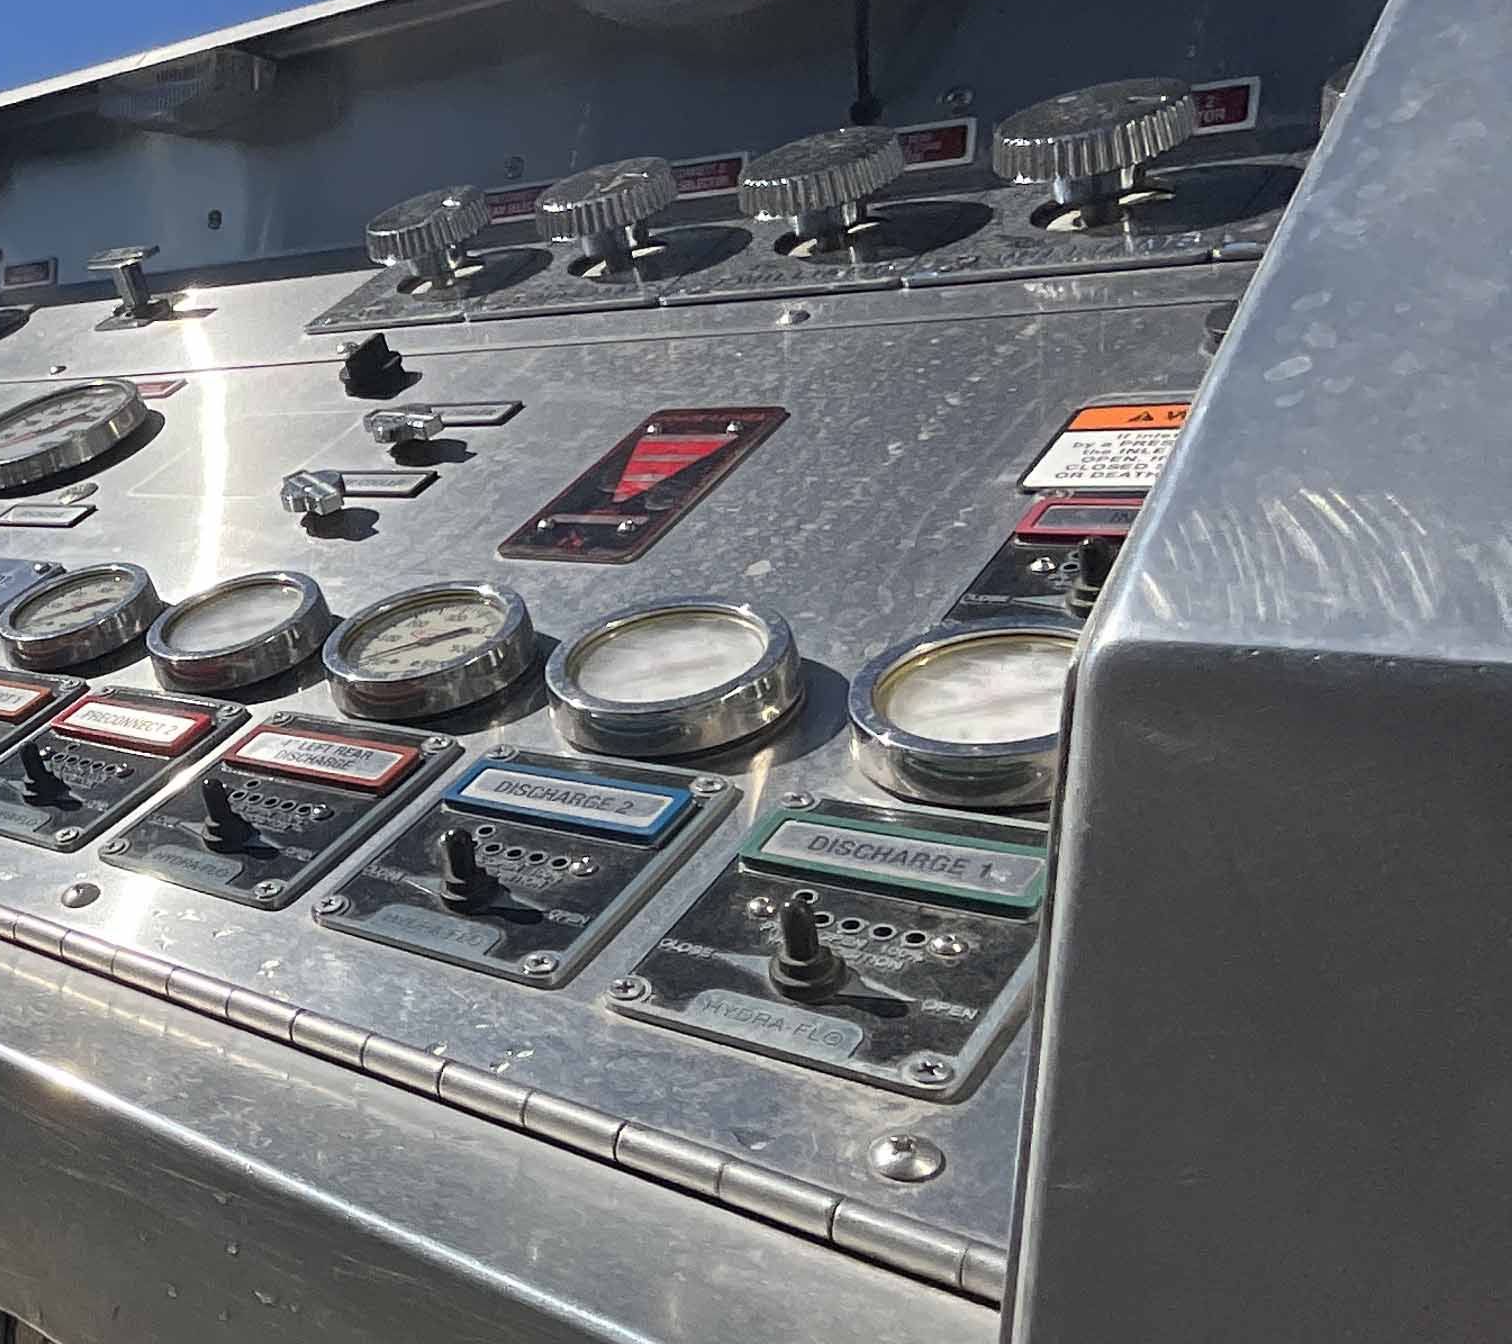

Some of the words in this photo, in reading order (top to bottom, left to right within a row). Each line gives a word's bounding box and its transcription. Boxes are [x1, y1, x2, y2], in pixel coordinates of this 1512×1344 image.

[80, 710, 166, 733] PRECONNECT
[164, 724, 179, 735] 2
[272, 749, 356, 769] DISCHARGE
[297, 740, 334, 754] LEFT
[334, 745, 375, 760] REAR
[493, 779, 617, 811] DISCHARGE
[615, 800, 634, 814] 2
[806, 834, 972, 877] DISCHARGE
[978, 863, 992, 878] 1
[920, 998, 980, 1021] OPEN
